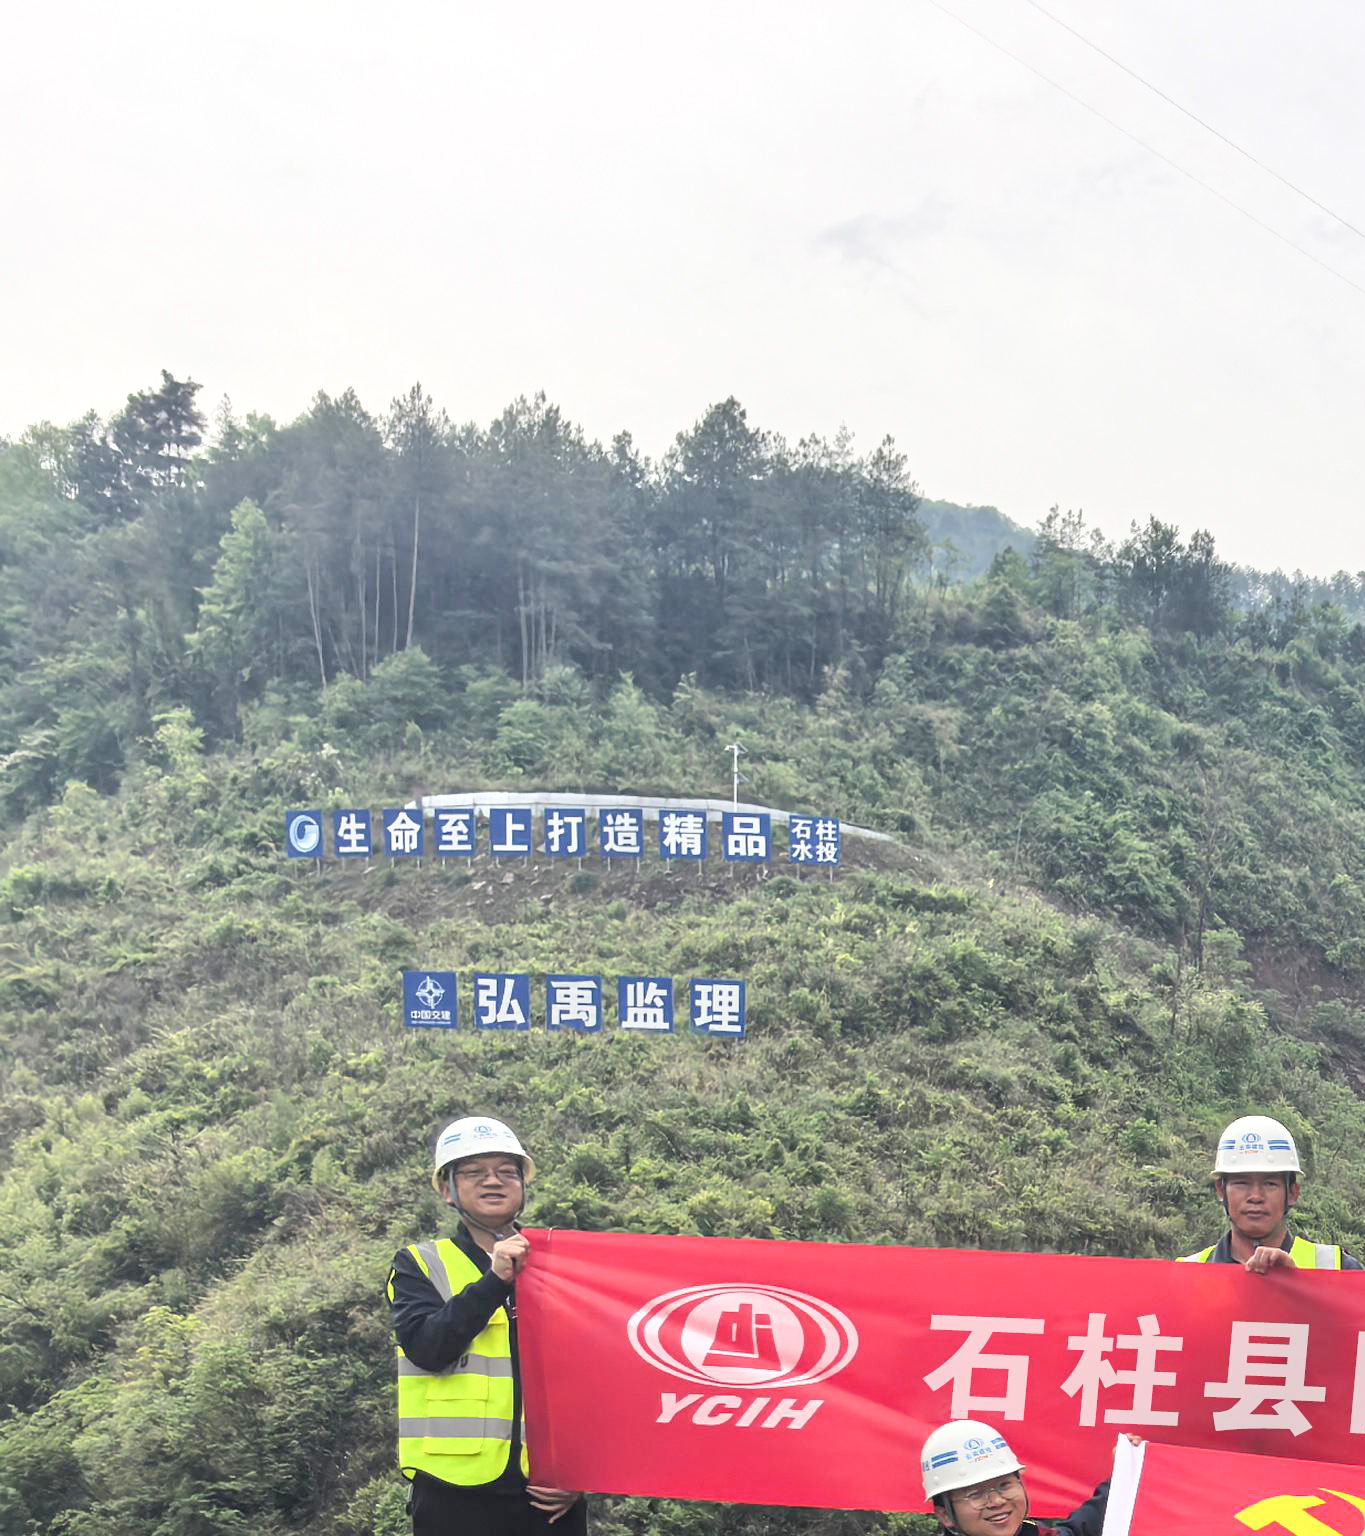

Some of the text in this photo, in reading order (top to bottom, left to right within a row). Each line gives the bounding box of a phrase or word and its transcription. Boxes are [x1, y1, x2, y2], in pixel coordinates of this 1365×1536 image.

[337, 812, 769, 858] 生命至上打造精品
[791, 818, 838, 841] 石柱
[791, 839, 838, 863] 水投
[477, 977, 742, 1032] 弘禹监理
[655, 1392, 824, 1430] YCIH
